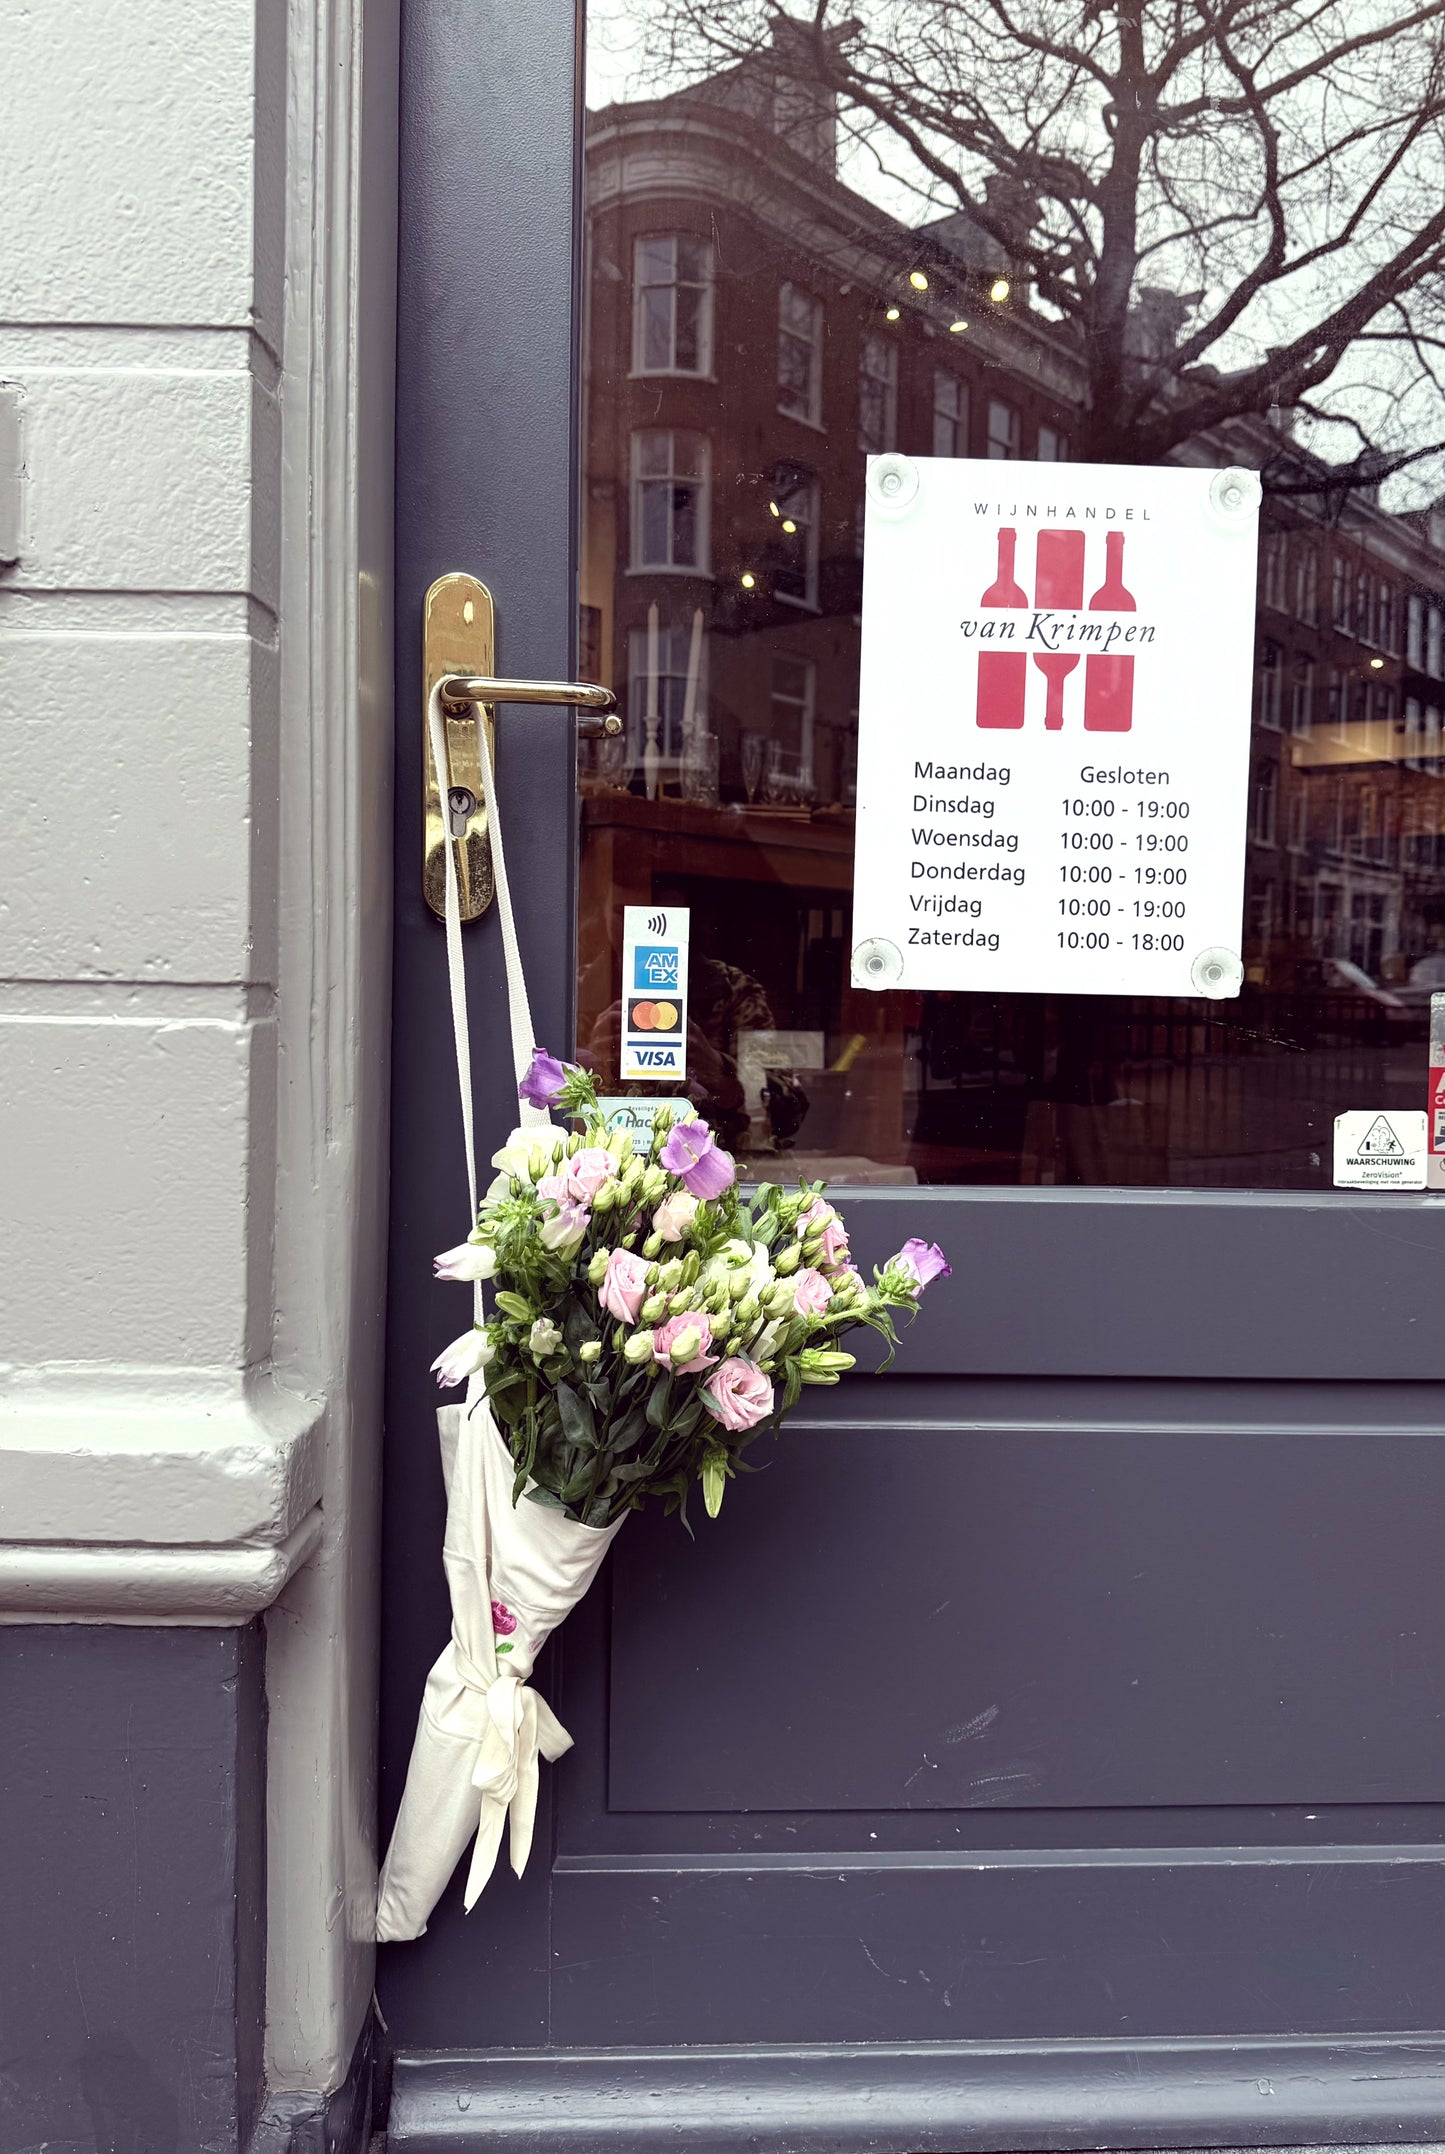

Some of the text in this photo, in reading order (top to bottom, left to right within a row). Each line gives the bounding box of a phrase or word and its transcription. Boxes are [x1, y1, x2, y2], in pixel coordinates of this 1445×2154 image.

[974, 502, 1151, 521] WIJNHANDEL
[960, 613, 1156, 652] van Krimpen
[914, 761, 1170, 786] Maandag Gesloten
[913, 794, 995, 819] Dinsdag
[1062, 798, 1115, 818] 10:00
[1137, 800, 1190, 819] 19:00
[911, 828, 1019, 853] Woensdag
[1060, 832, 1114, 851] 10:00
[1135, 833, 1189, 853] 19:00
[911, 861, 1026, 887] Donderdag
[1059, 865, 1113, 884] 10:00
[1134, 867, 1187, 886] 19:00
[908, 894, 982, 918] Vrijdag
[1058, 898, 1111, 917] 10:00
[1133, 900, 1186, 919] 19:00
[907, 927, 1000, 952] Zaterdag
[1057, 931, 1110, 950] 10:00
[1131, 933, 1185, 952] 18:00
[633, 1051, 676, 1066] VISA
[1346, 1158, 1416, 1166] WAARSCHUWING
